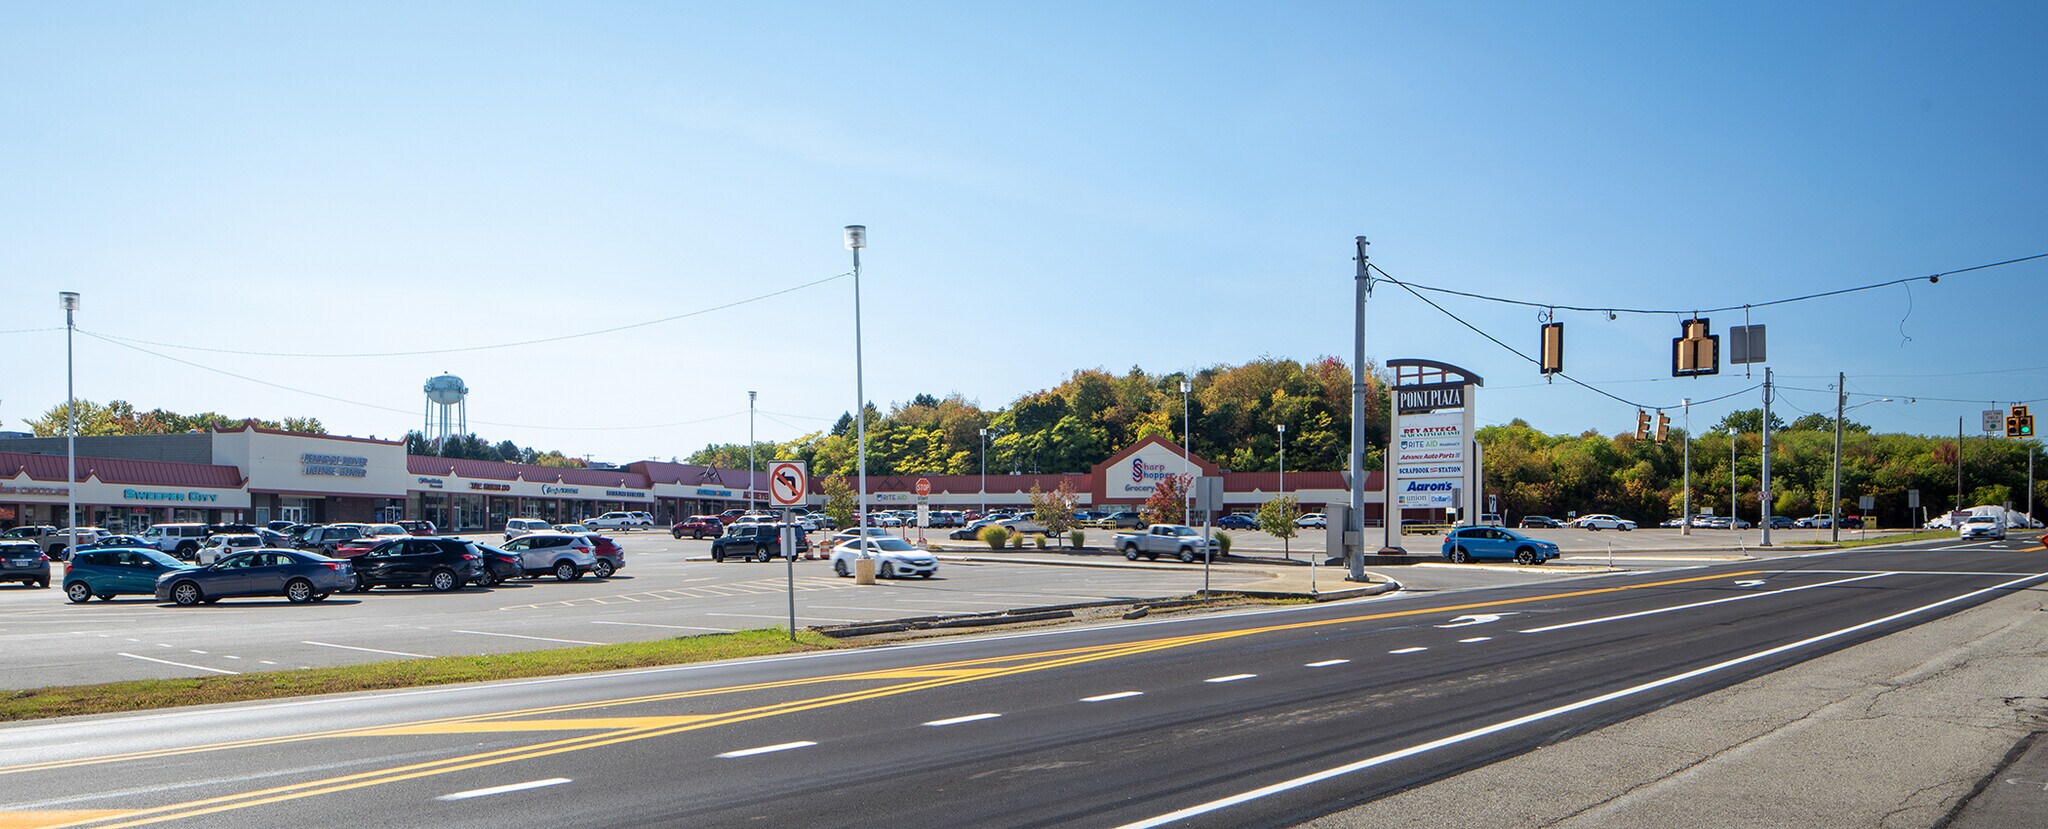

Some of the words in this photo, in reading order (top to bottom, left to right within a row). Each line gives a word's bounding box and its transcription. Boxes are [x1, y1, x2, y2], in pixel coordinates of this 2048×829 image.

[1400, 391, 1428, 408] POINT
[1431, 389, 1461, 406] PLAZA
[1408, 440, 1424, 448] RITE
[1125, 484, 1155, 493] Grocery
[1407, 481, 1452, 491] Aaron's
